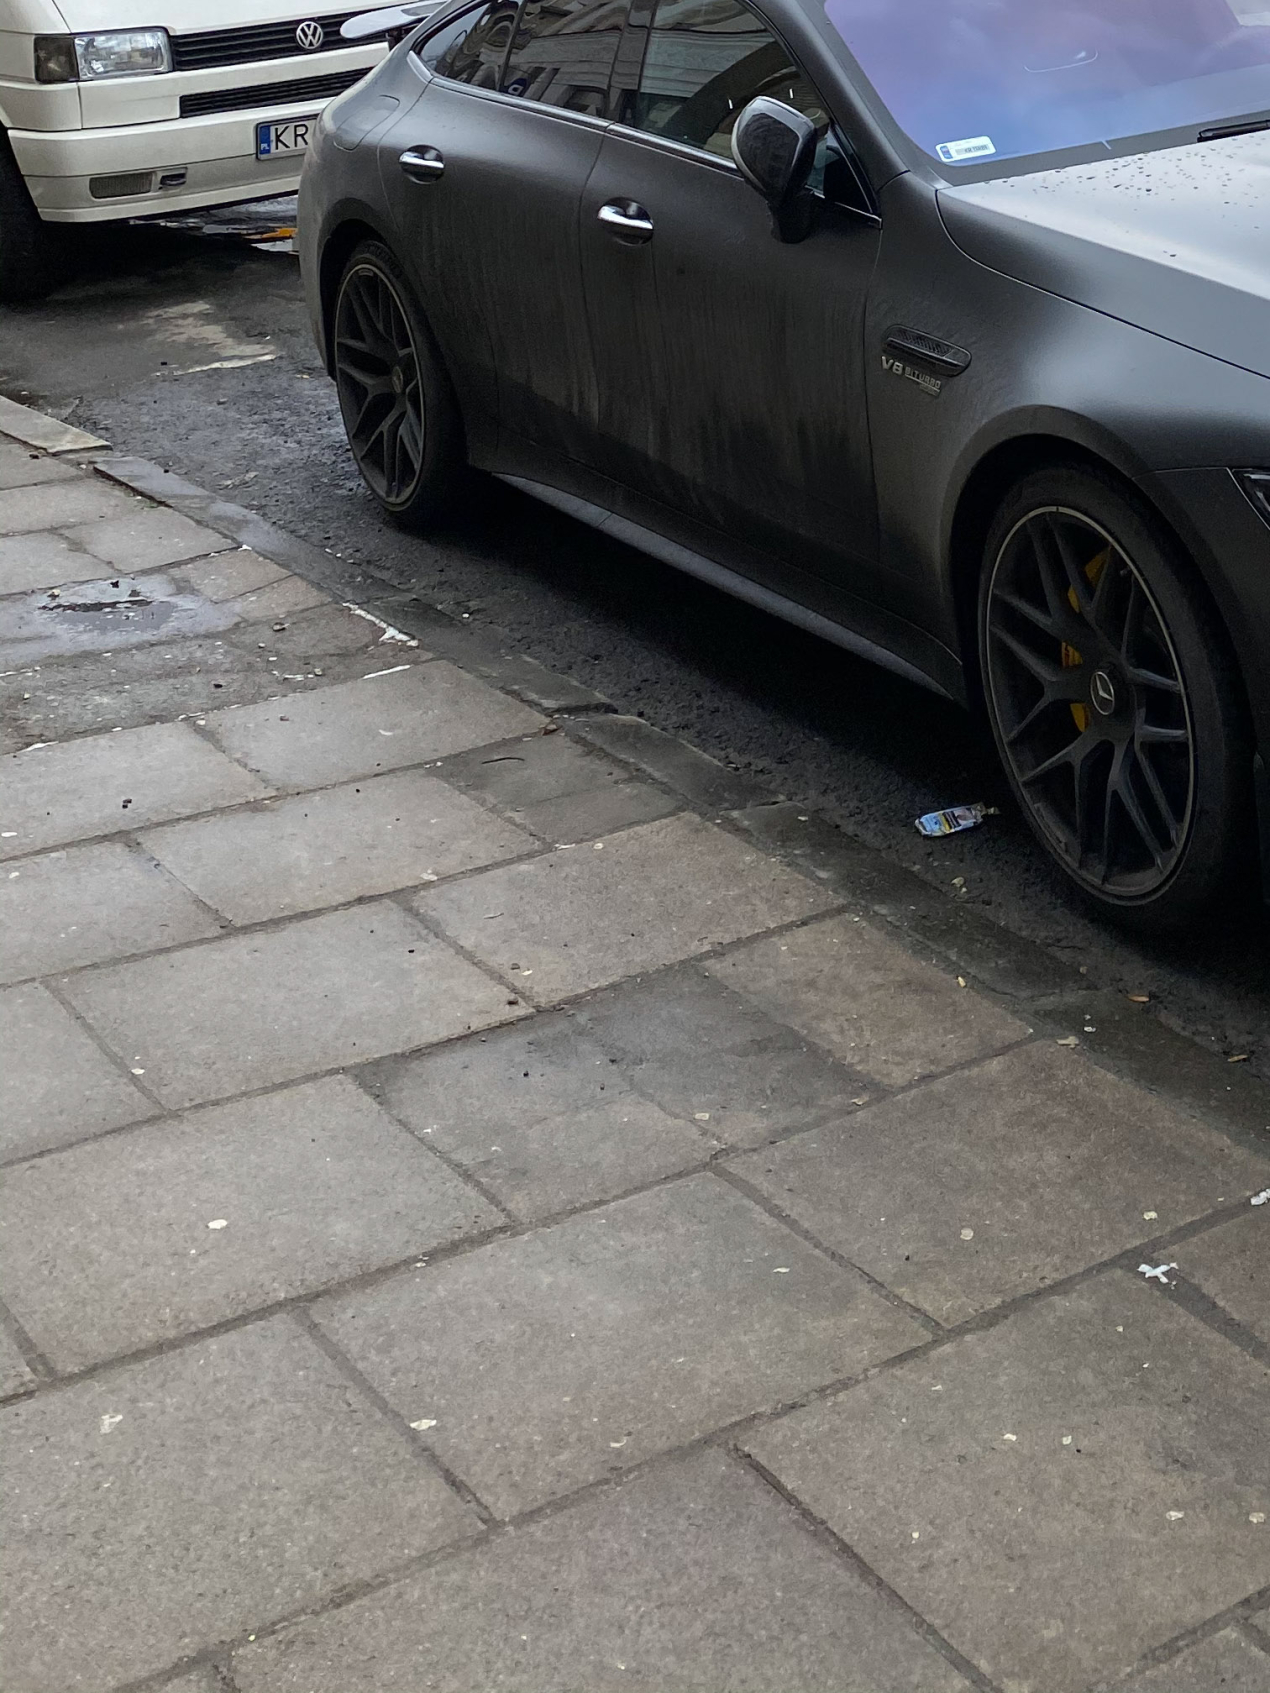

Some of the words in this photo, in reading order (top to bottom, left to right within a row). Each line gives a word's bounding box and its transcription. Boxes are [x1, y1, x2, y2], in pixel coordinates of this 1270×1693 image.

[275, 124, 309, 150] KR
[881, 356, 904, 375] V8
[905, 366, 941, 389] BITURBO
